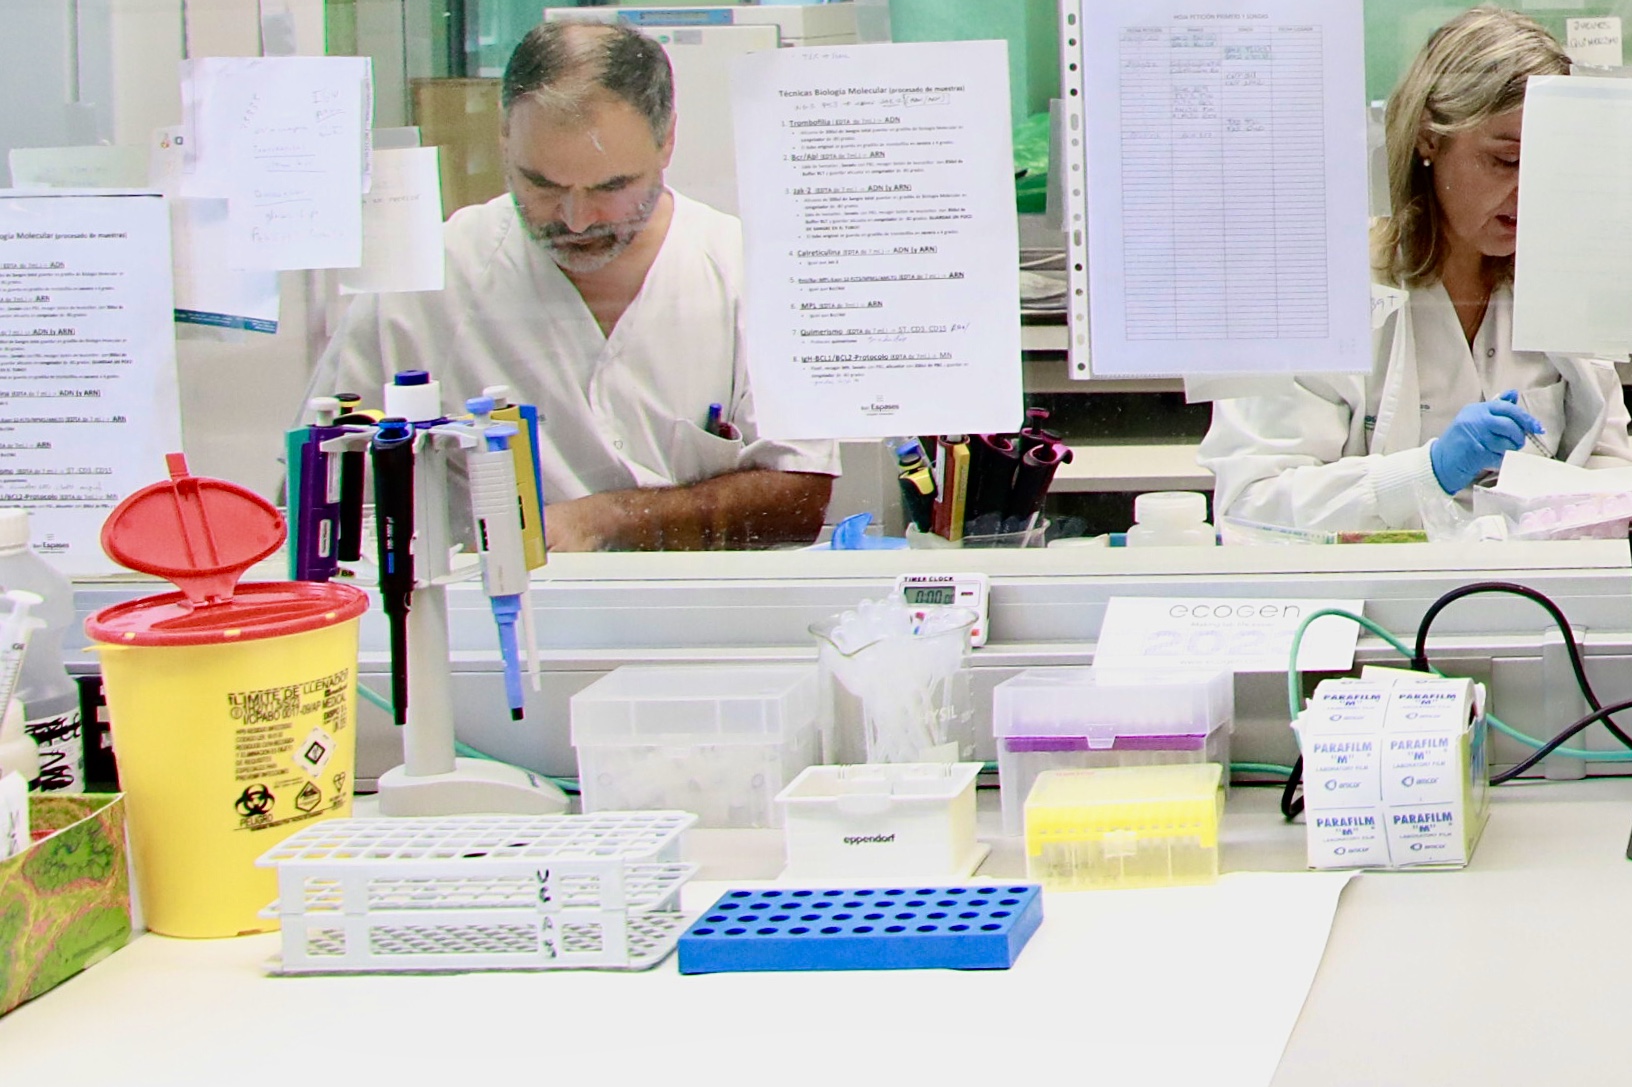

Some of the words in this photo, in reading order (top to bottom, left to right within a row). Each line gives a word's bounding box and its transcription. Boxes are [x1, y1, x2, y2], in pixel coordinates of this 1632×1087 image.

[779, 89, 812, 97] Técnicas
[848, 86, 887, 95] Molecular
[889, 86, 923, 94] (procesado
[934, 85, 965, 93] muestras)
[789, 119, 831, 127] Trombofilia
[893, 184, 912, 192] ARN)
[797, 249, 841, 257] Calreticulina
[800, 329, 843, 337] Quimerismo
[871, 403, 899, 411] Espases
[1169, 604, 1300, 618] ecogen
[233, 692, 281, 706] LIMITE
[284, 688, 300, 700] DE
[303, 675, 346, 694] LLENADO
[1313, 742, 1372, 753] PARAFILM
[1390, 738, 1448, 750] PARAFILM
[240, 814, 273, 827] PELIGRO
[1316, 816, 1375, 828] PARAFILM
[1393, 812, 1452, 824] PARAFILM
[843, 832, 896, 845] eppendorf
